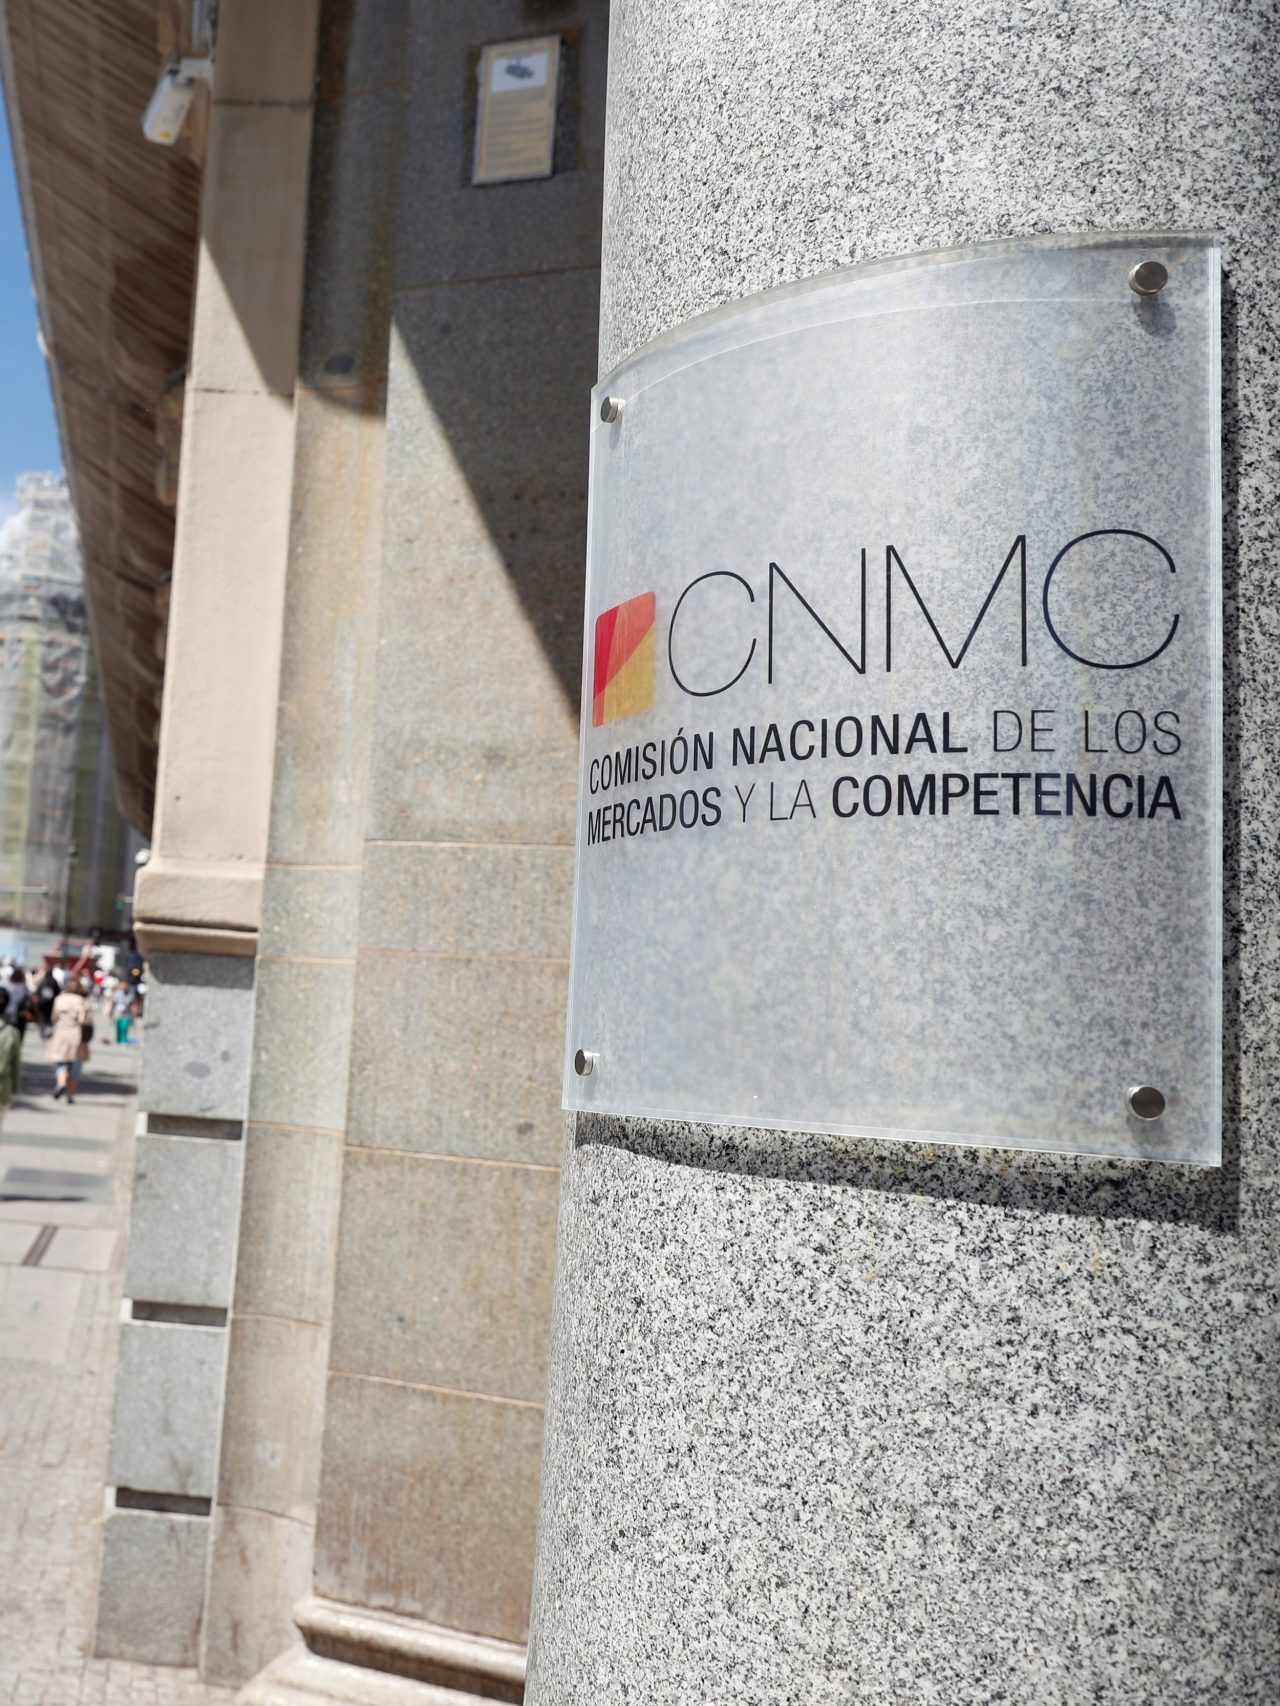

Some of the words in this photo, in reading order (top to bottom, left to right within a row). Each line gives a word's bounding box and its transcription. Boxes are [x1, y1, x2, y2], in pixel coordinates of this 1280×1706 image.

[667, 528, 1181, 698] CNMC
[589, 727, 714, 795] COMISIÓN
[732, 711, 969, 767] NACIONAL
[993, 709, 1056, 753] DE
[1084, 709, 1182, 755] LOS
[587, 786, 722, 846] MERCADOS
[734, 782, 756, 823] Y
[769, 779, 817, 821] LA
[831, 772, 1182, 820] COMPETENCIA
